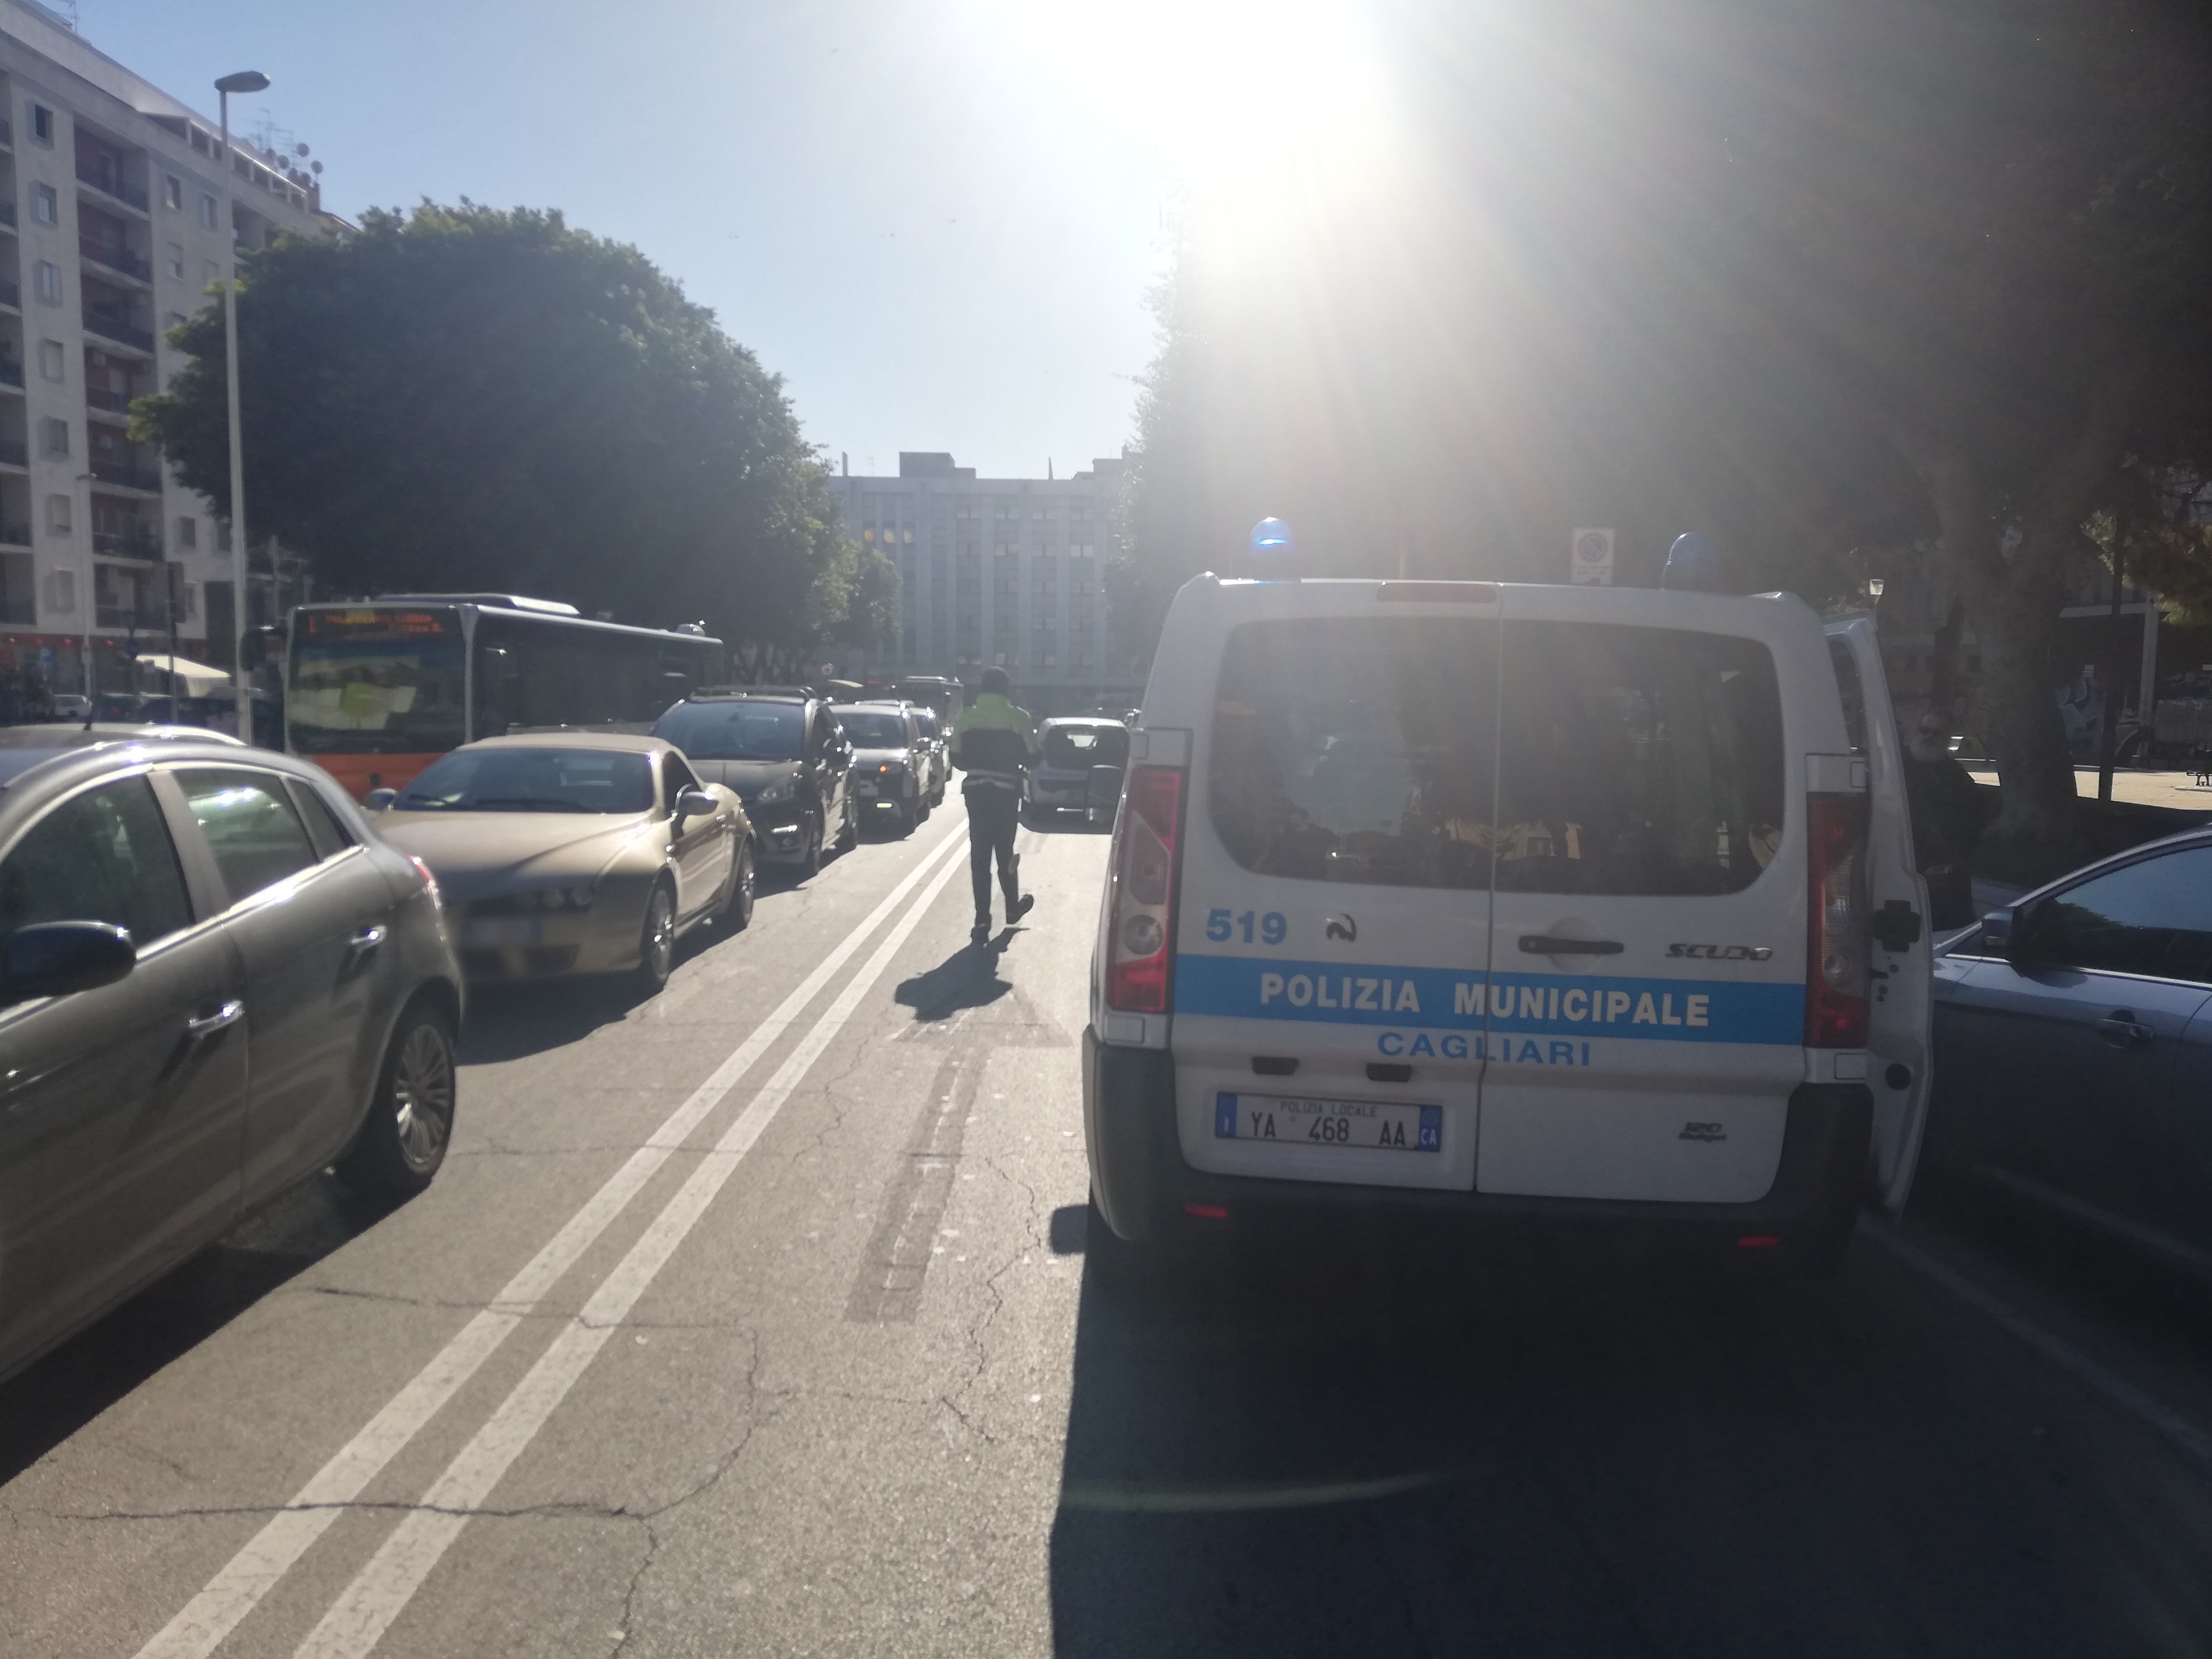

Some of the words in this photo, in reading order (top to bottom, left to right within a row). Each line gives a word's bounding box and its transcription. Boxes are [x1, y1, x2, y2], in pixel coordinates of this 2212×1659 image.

[1206, 909, 1287, 944] 519
[1260, 972, 1420, 1012] POLIZIA
[1454, 983, 1709, 1027] MUNICIPALE
[1377, 1031, 1589, 1066] CAGLIARI
[1280, 1101, 1324, 1114] POLIZIA
[1331, 1104, 1377, 1117] LOCALE
[1251, 1111, 1276, 1138] YA
[1308, 1116, 1349, 1142] 468
[1379, 1120, 1405, 1146] AA
[1420, 1128, 1437, 1145] CA
